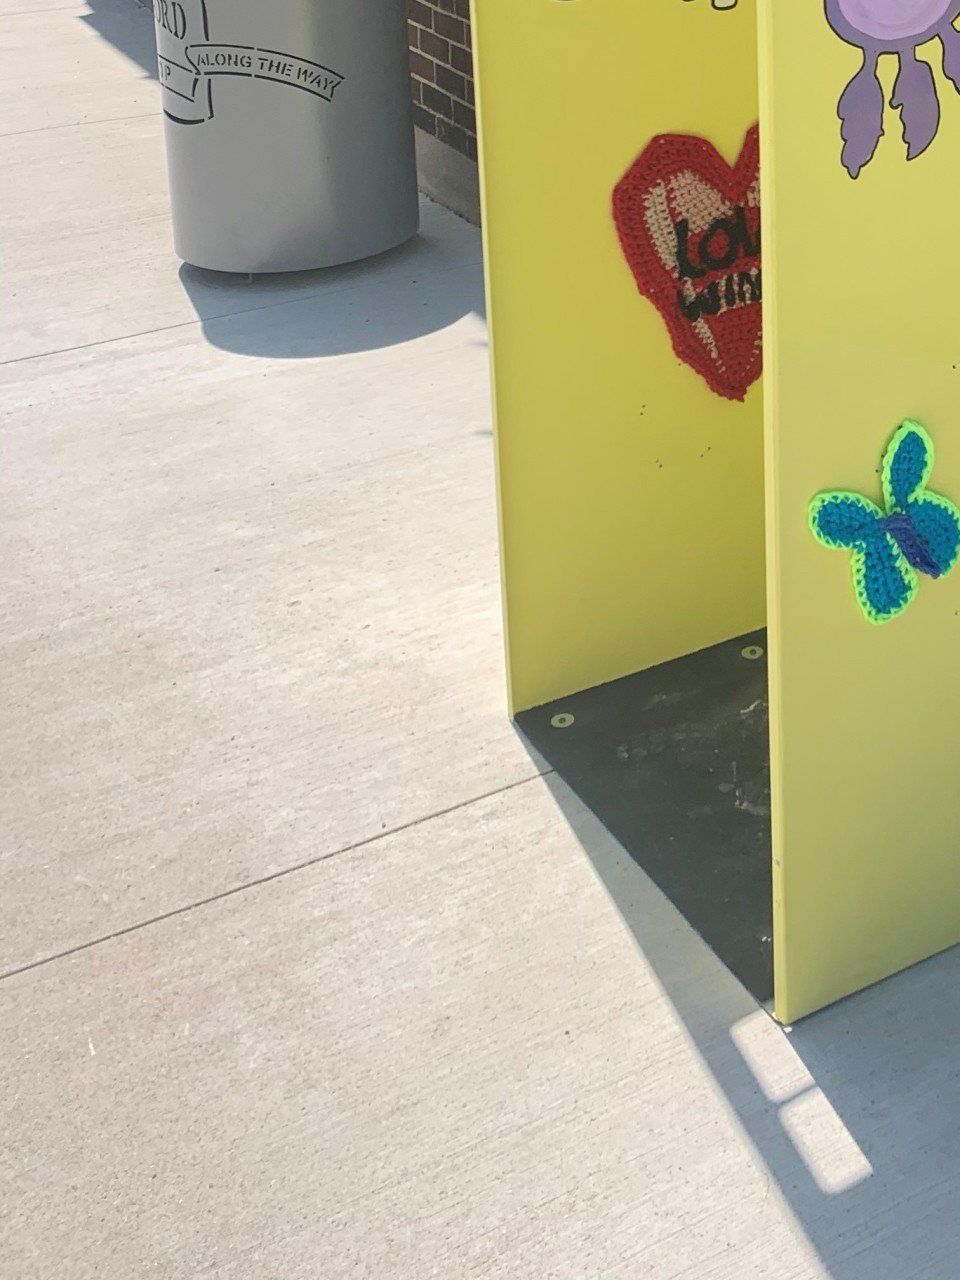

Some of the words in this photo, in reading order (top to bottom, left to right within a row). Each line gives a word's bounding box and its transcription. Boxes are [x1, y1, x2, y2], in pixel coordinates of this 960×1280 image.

[196, 53, 253, 69] ALONG
[257, 57, 295, 77] THE
[297, 66, 335, 92] WAY
